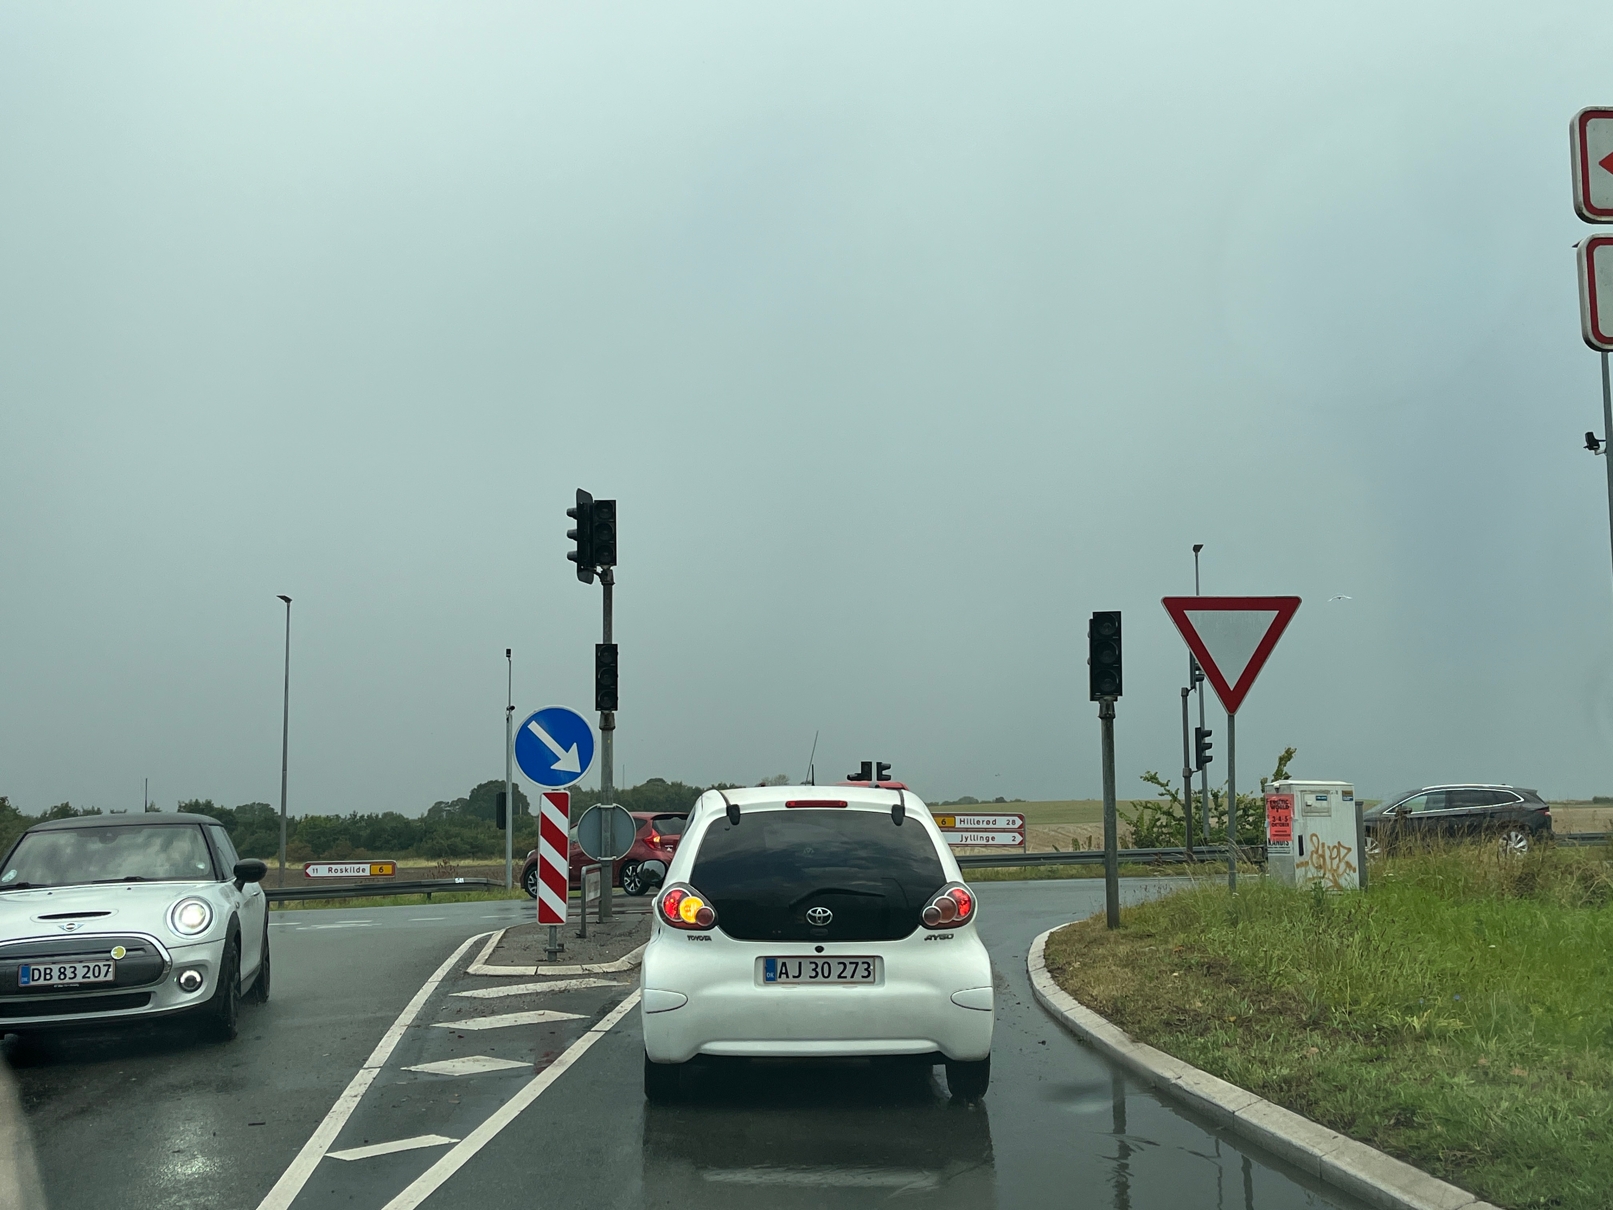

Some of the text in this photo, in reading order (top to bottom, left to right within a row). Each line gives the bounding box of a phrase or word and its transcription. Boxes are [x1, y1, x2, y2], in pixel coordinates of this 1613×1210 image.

[959, 818, 997, 826] Hillerød
[959, 834, 996, 843] Jyllinge
[327, 866, 366, 874] Roskilde
[924, 933, 954, 941] AYGO
[31, 963, 112, 982] DB 83 207
[778, 961, 872, 979] AJ 30 273
